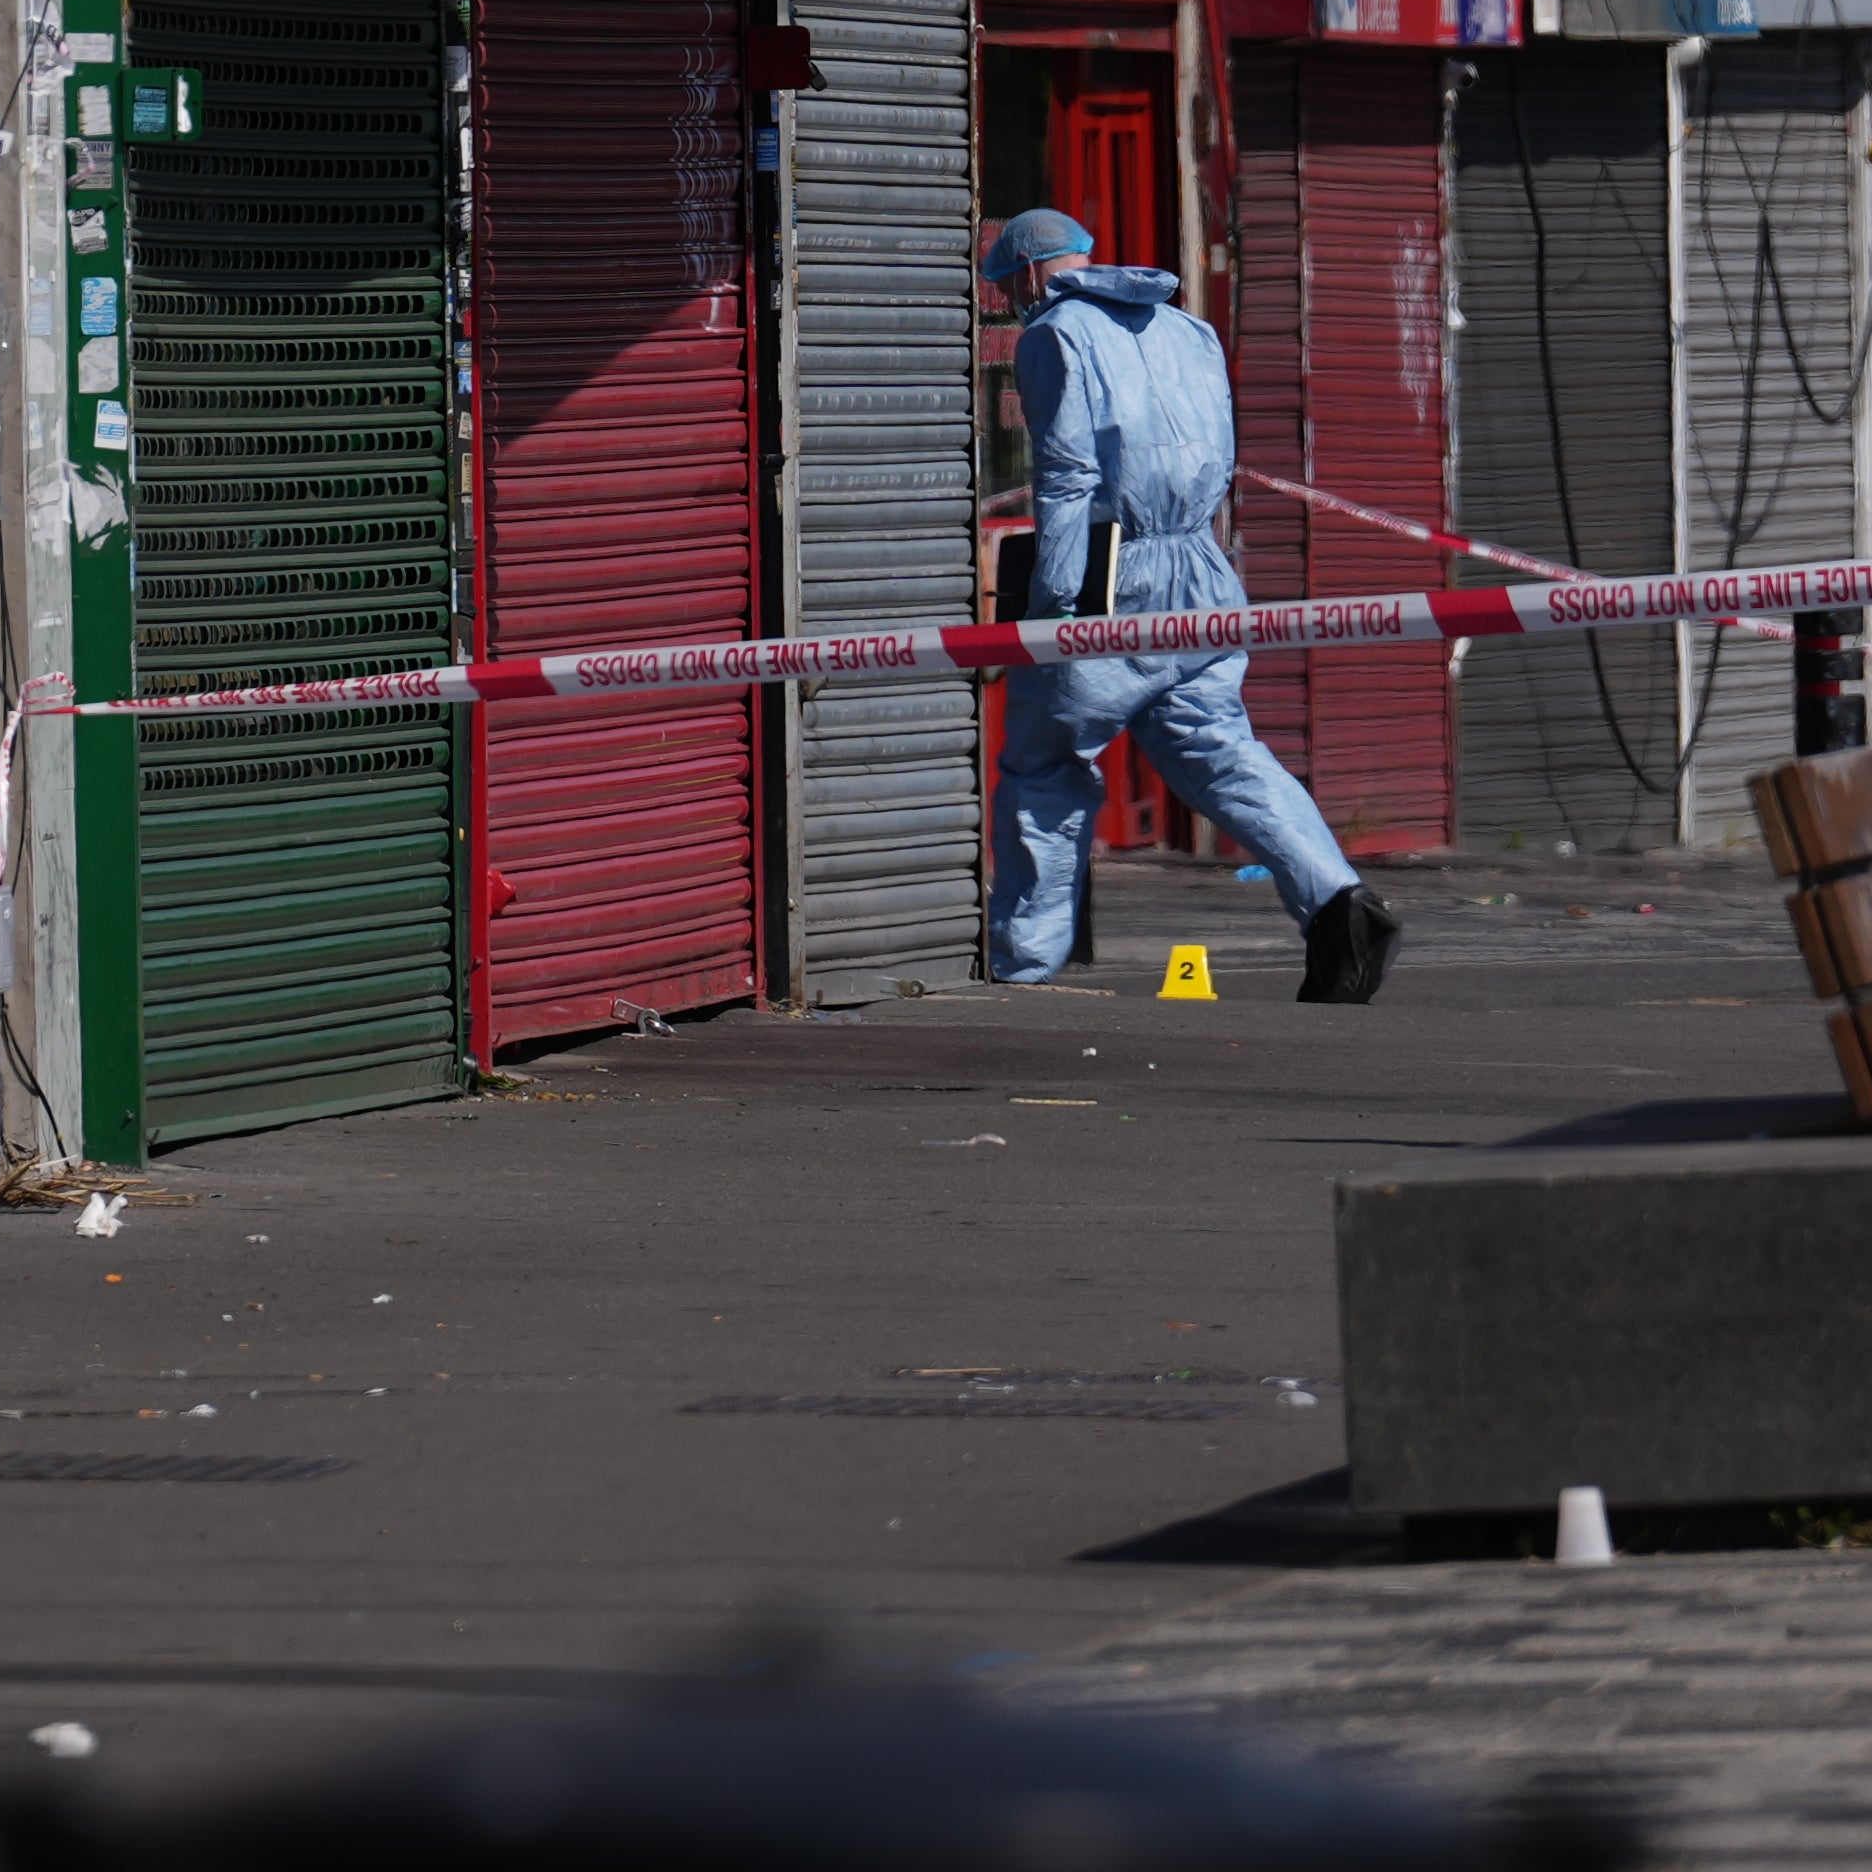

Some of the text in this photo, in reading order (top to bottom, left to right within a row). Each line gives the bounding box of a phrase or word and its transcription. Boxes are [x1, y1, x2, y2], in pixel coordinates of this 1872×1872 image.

[1548, 584, 1636, 623] CROSS
[1642, 578, 1694, 617] NOT
[1701, 576, 1740, 612] DO
[1746, 570, 1805, 609] LINE
[1056, 600, 1403, 656] POLICE LINE DO NOT CROSS
[576, 633, 915, 689] POLICE LINE DO NOT CROSS
[354, 671, 441, 700] POLICE
[1180, 962, 1194, 980] 2
